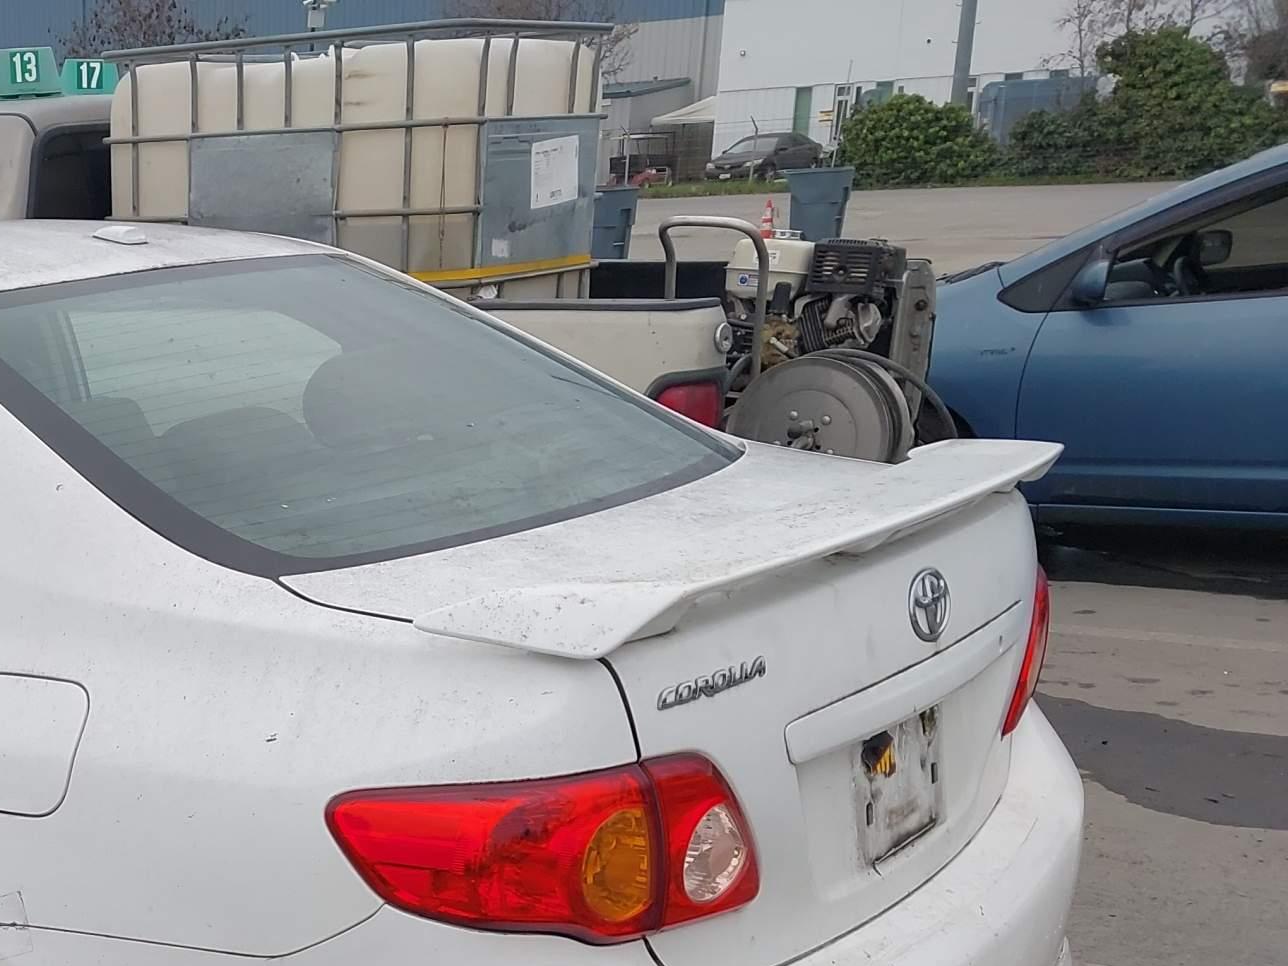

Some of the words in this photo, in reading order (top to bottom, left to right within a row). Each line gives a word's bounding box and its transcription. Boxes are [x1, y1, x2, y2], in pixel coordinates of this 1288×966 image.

[13, 52, 37, 82] 13
[79, 62, 101, 89] 17
[656, 655, 767, 711] COROLLA
